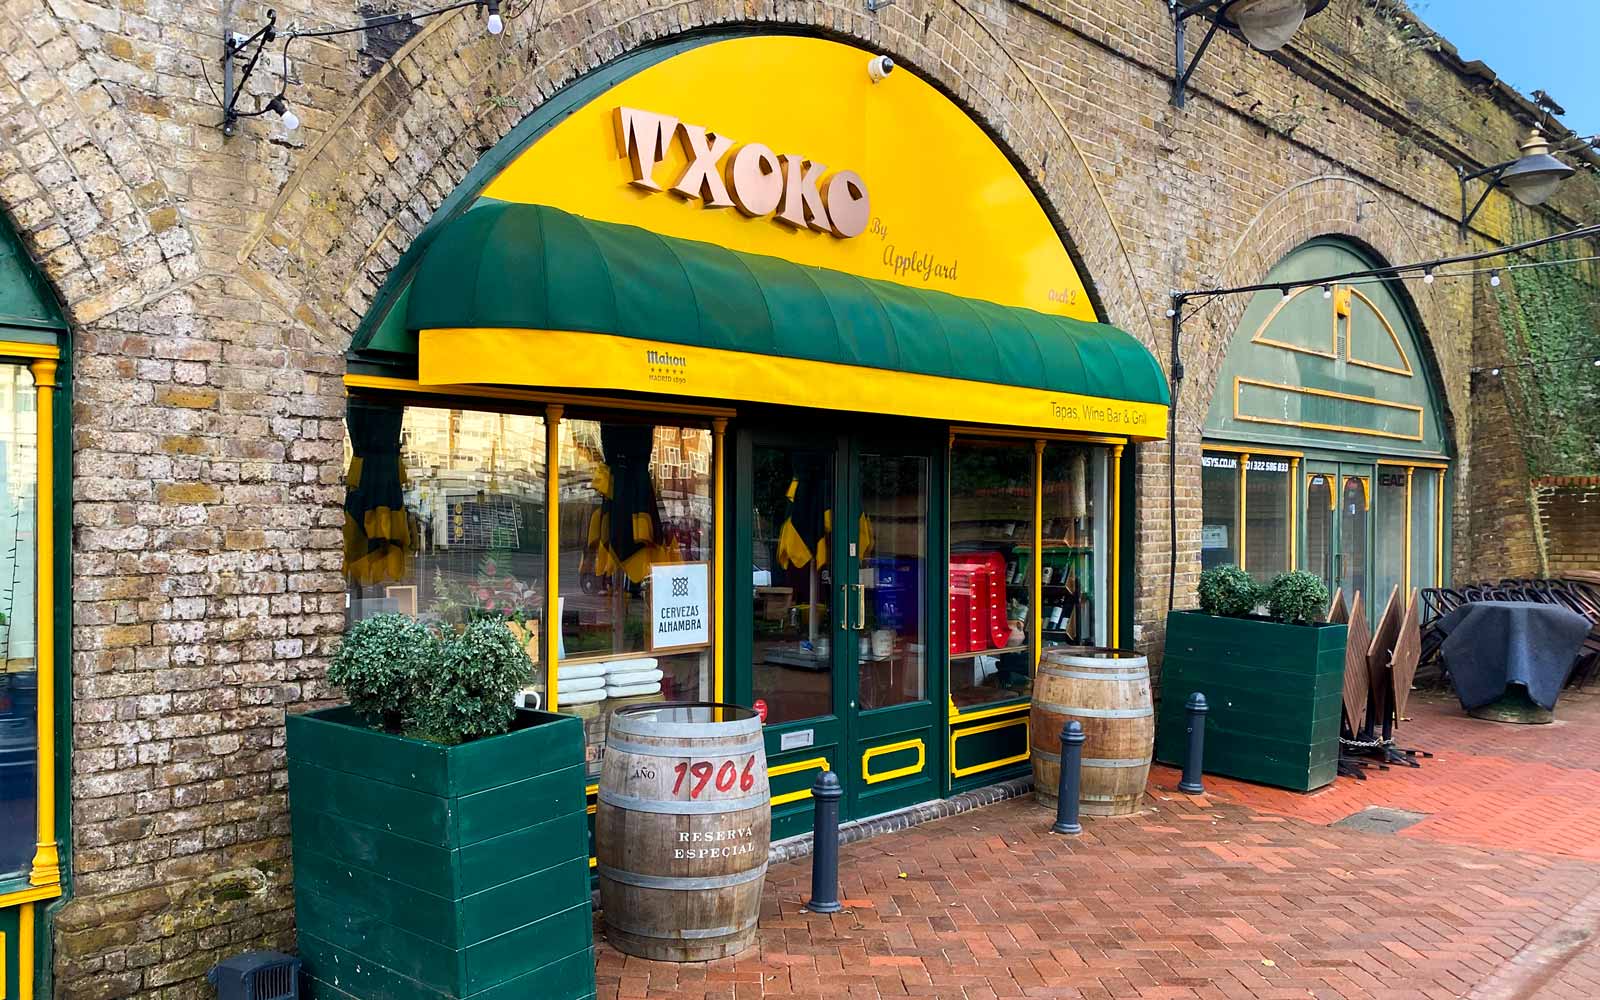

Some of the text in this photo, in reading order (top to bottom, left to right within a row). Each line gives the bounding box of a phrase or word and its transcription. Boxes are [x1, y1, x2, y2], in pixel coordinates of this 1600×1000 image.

[612, 106, 870, 239] TXOKO
[869, 217, 888, 240] By
[882, 244, 958, 281] AppleYard
[1070, 289, 1077, 305] 2
[647, 350, 686, 367] Mahou
[1050, 401, 1080, 422] Tapas,
[1082, 404, 1105, 421] Wine
[1107, 407, 1121, 423] Bar
[1124, 409, 1130, 424] &
[660, 605, 699, 619] CERVEZAS
[658, 619, 702, 633] ALHAMBRA
[632, 754, 756, 799] AÑO 1906
[679, 826, 753, 842] RESERVA
[673, 843, 755, 859] ESPECIAL
